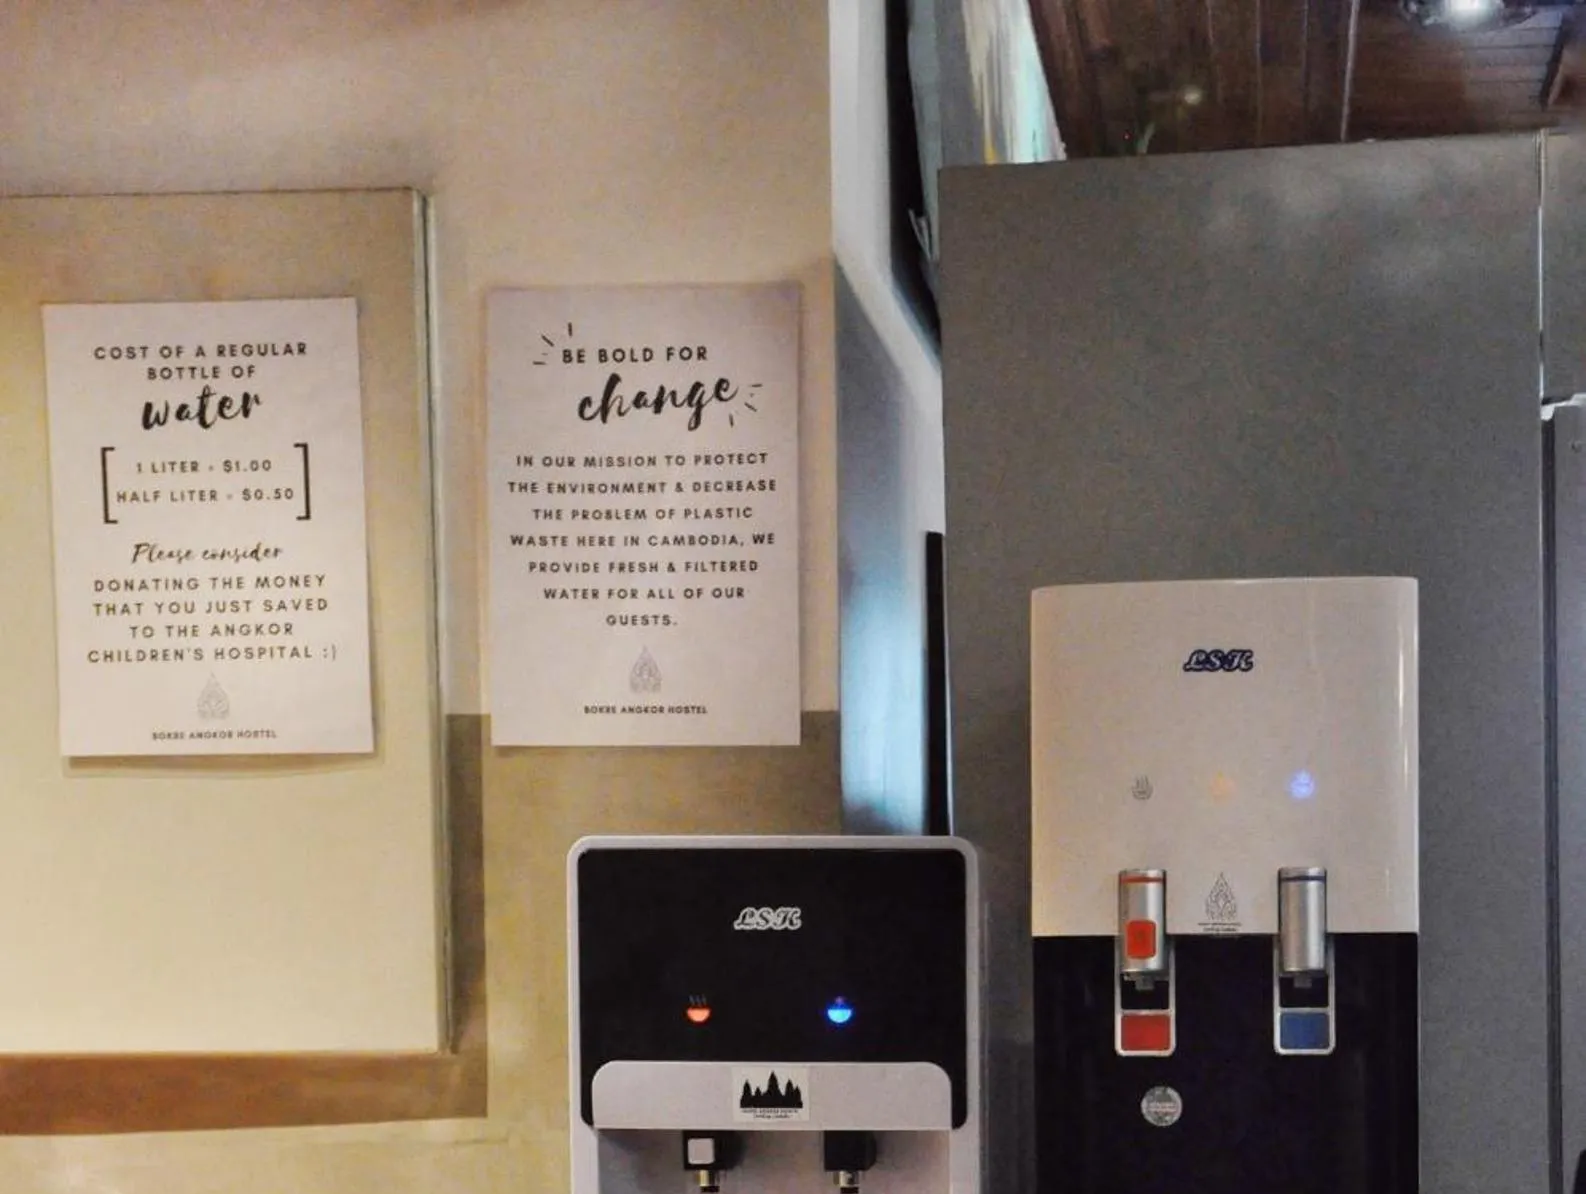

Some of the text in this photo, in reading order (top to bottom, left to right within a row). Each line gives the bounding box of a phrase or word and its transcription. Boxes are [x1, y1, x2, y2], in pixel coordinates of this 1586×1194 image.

[93, 342, 307, 360] COST OF A REGULAR
[562, 346, 708, 364] BE BOLD FOR
[147, 364, 256, 380] BOTTLE OF
[141, 384, 262, 431] water
[577, 372, 739, 432] change
[136, 462, 143, 474] 1
[151, 460, 200, 474] LITER
[223, 459, 272, 474] $1.00
[516, 452, 769, 468] IN OUR MISSION TO PROTECT
[508, 479, 777, 495] THE ENVIRONMENT & DECREASE
[116, 490, 161, 503] HALF
[170, 489, 218, 503] LITER
[242, 488, 294, 502] $0.50
[533, 506, 754, 521] THE PROBLEM OF PLASTIC
[510, 532, 775, 547] WASTE HERE IN CAMBODIA, WE
[131, 541, 283, 565] Please consider
[529, 559, 759, 574] PROVIDE FRESH & FILTERED
[94, 574, 326, 592] DONATING THE MONEY
[544, 586, 745, 600] WATER FOR ALL OF OUR
[93, 597, 328, 617] THAT YOU JUST SAVED
[606, 613, 679, 627] GUESTS.
[129, 622, 293, 639] TO THE ANGKOR
[87, 647, 204, 664] CHILDREN'S
[214, 645, 313, 661] HOSPITAL
